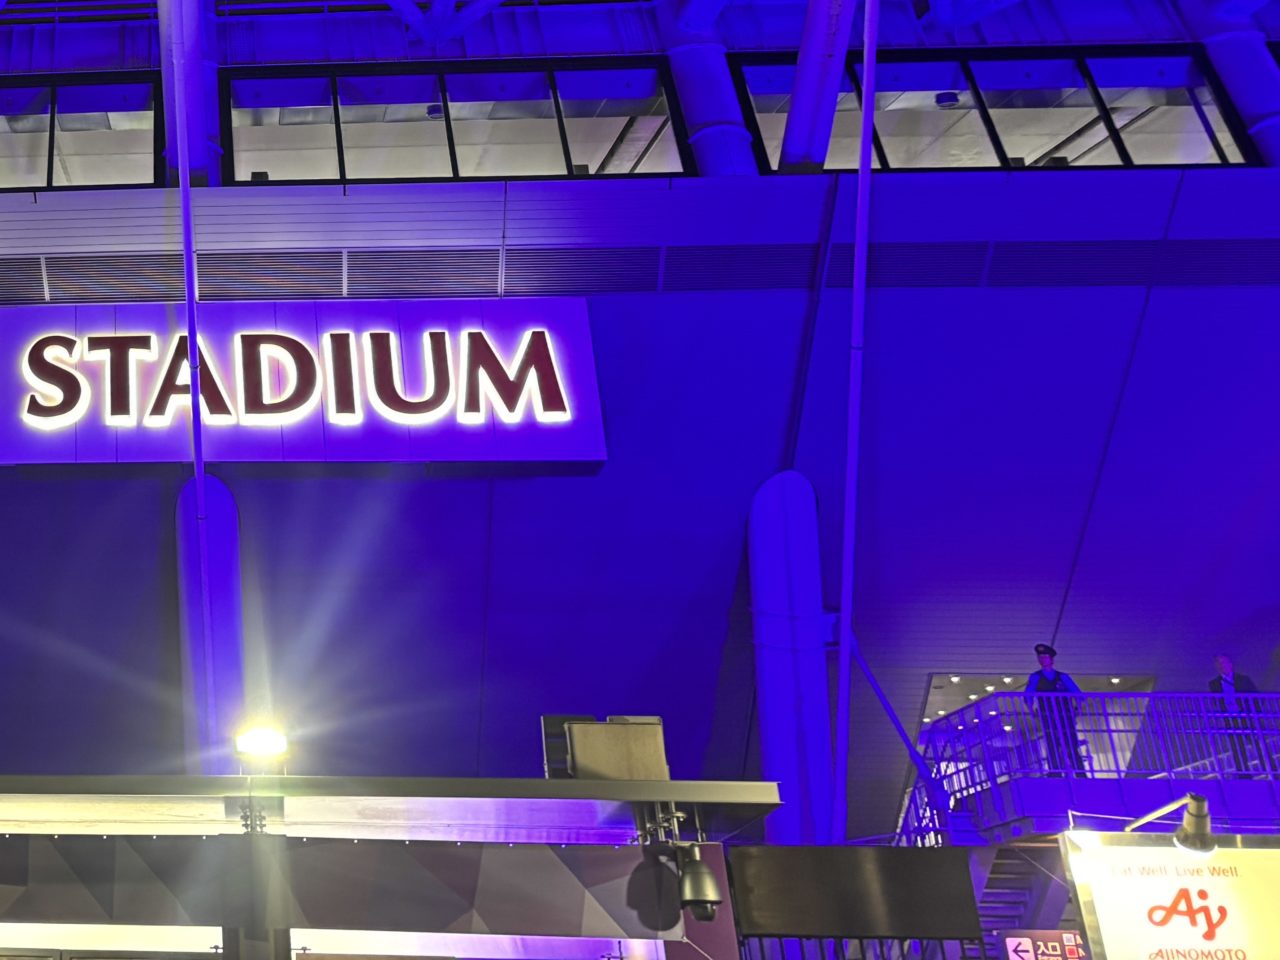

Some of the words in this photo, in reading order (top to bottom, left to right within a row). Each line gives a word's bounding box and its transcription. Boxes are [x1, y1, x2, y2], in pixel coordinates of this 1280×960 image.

[24, 329, 569, 419] STADIUM
[1175, 866, 1204, 877] Live
[1036, 941, 1061, 954] 入口
